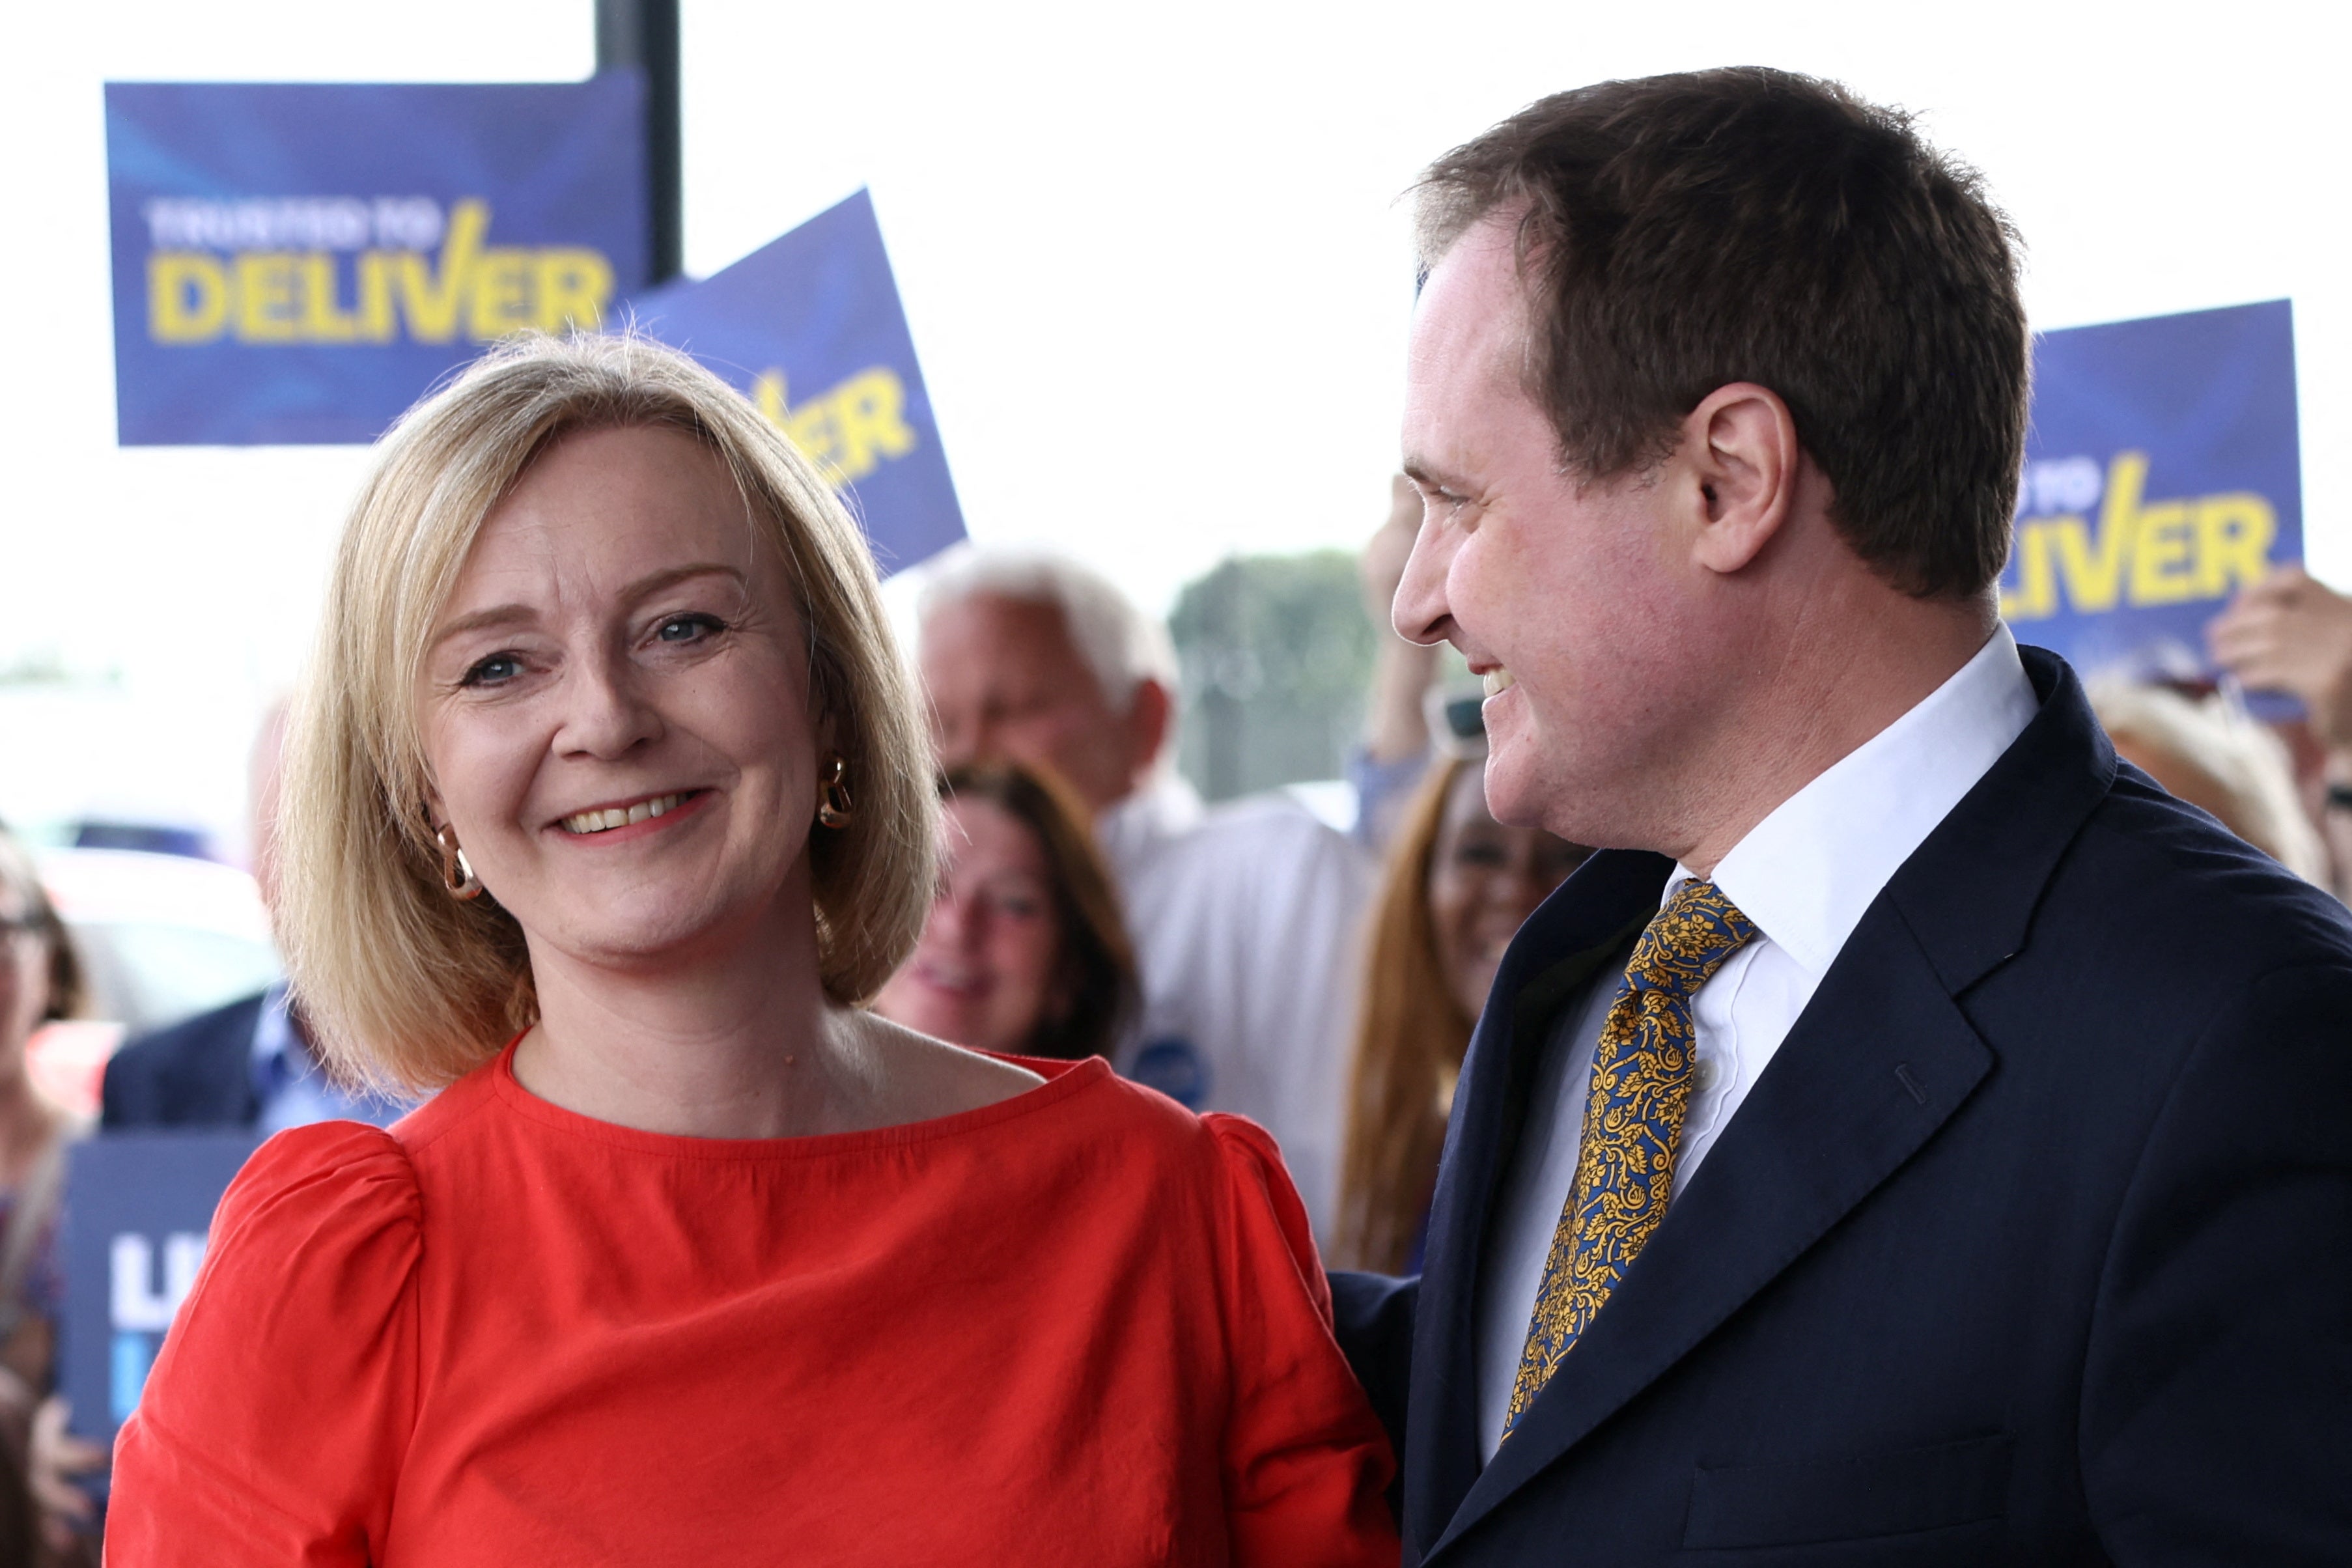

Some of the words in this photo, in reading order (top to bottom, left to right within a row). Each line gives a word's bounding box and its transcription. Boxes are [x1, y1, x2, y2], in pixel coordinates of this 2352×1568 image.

[147, 197, 369, 251] TRUSTED
[374, 197, 444, 251] TO
[148, 199, 613, 344] DELIVER
